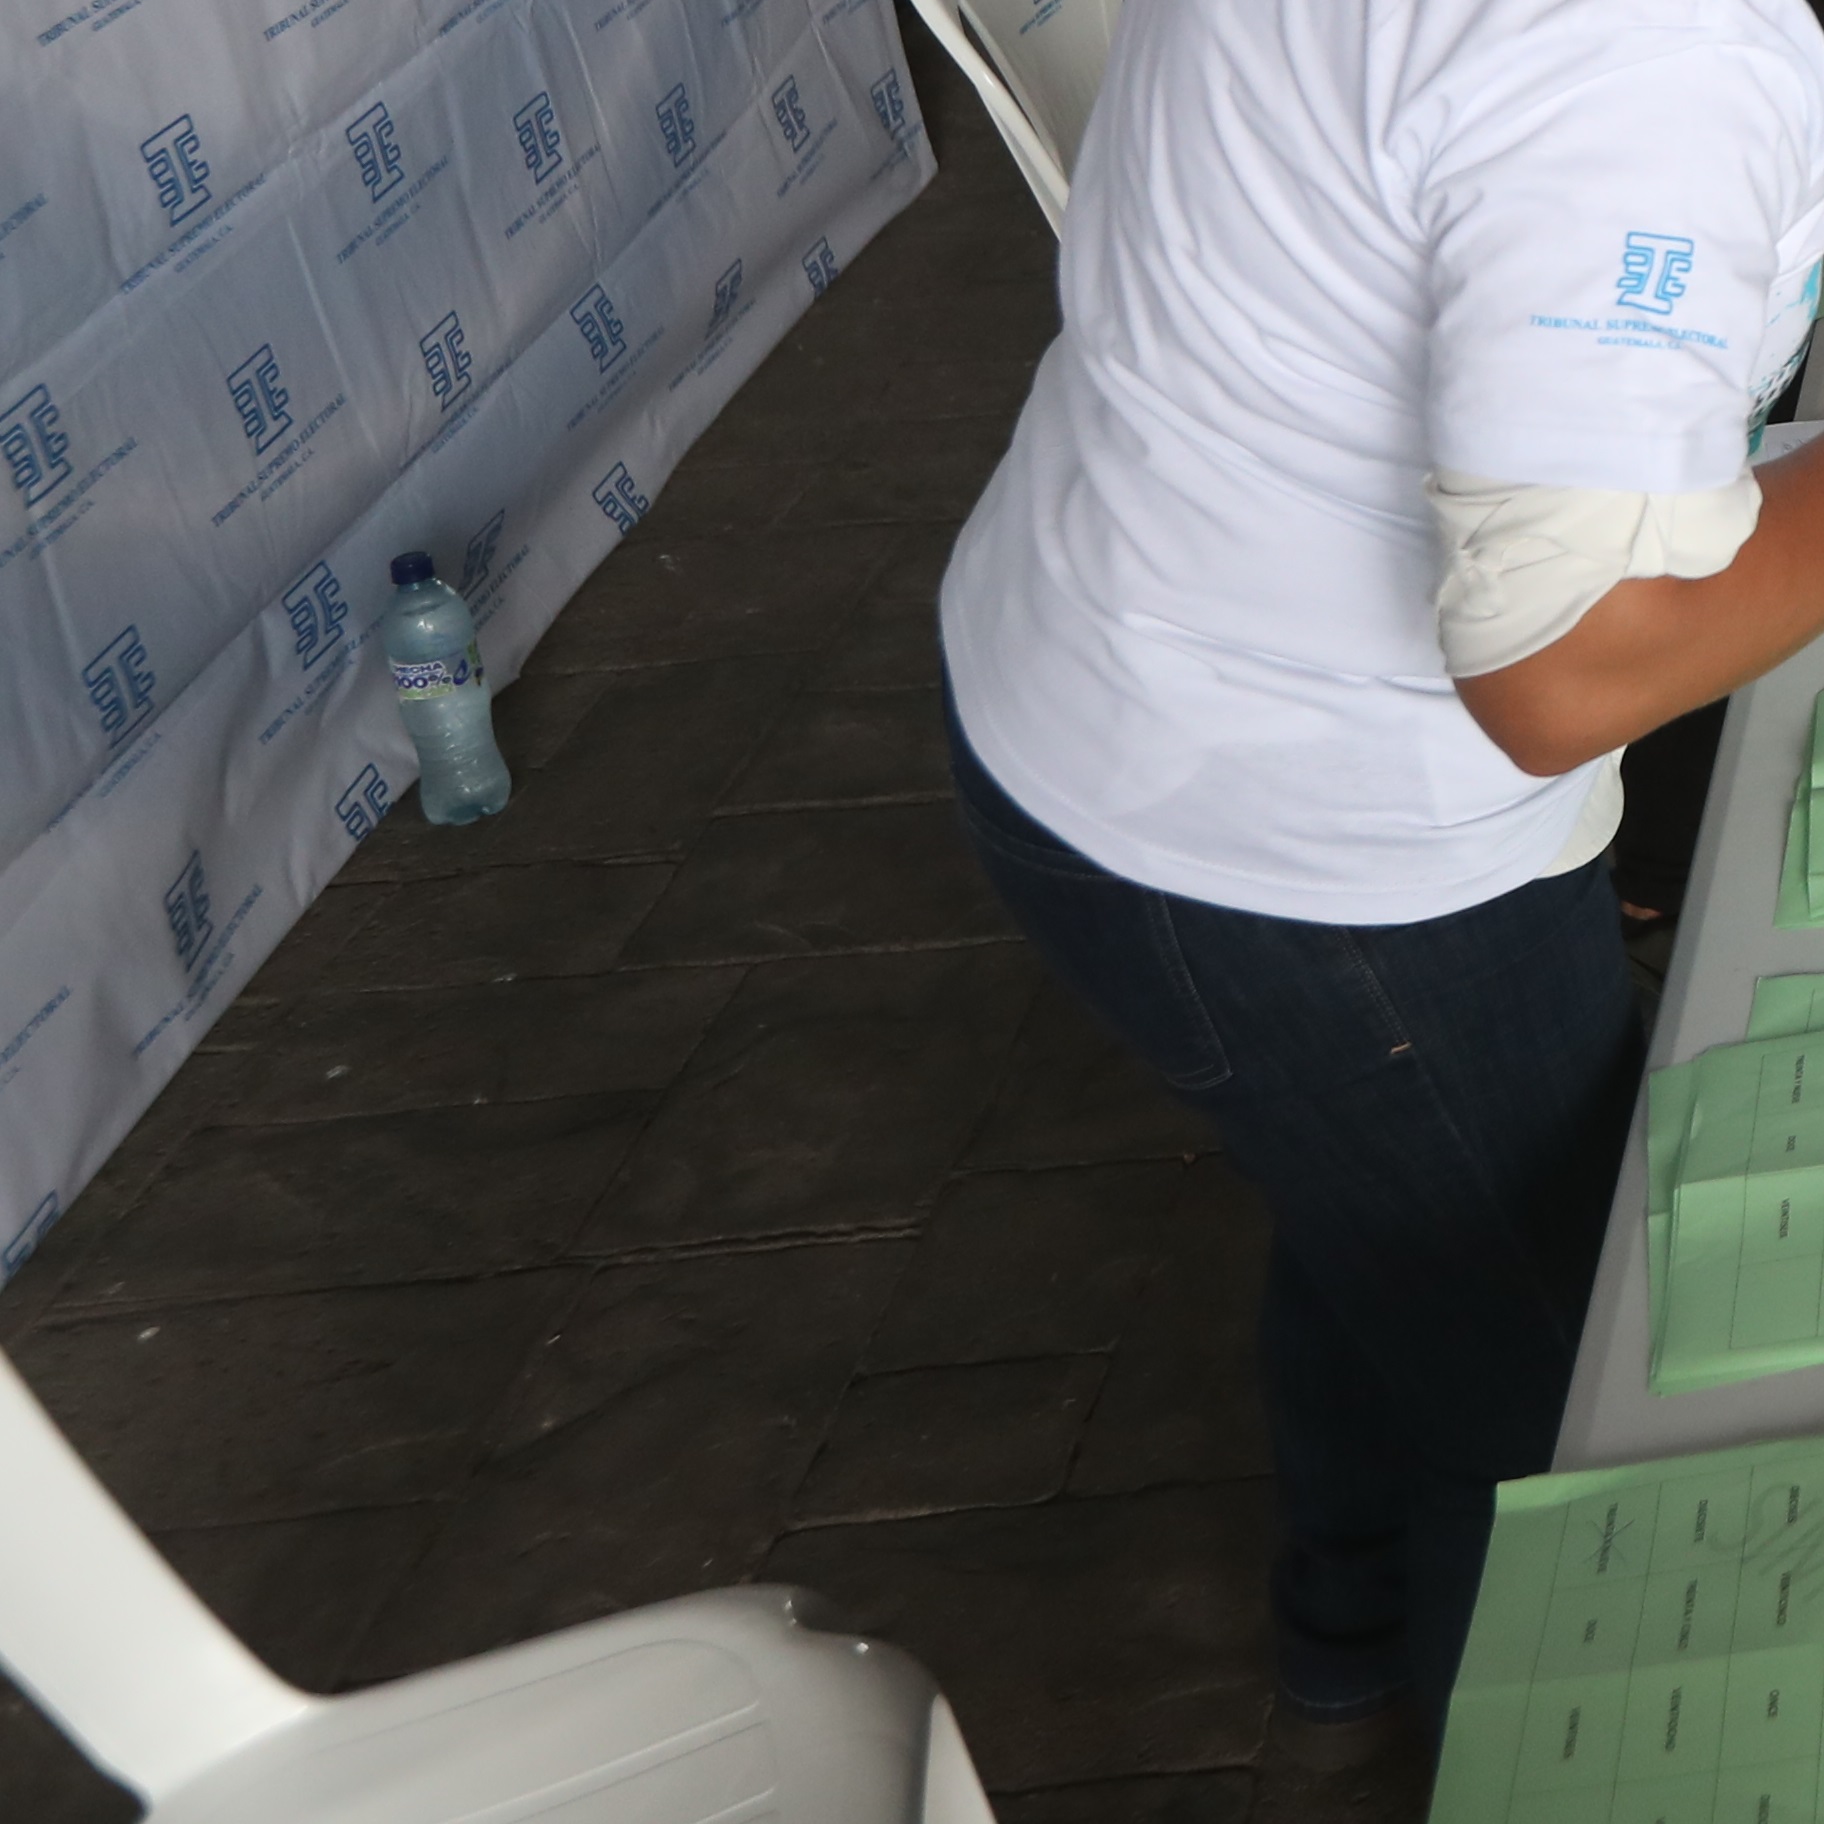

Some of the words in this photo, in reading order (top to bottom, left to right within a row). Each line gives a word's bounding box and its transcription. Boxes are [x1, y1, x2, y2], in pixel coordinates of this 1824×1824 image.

[36, 6, 91, 48] TRIBUNAL
[263, 4, 309, 42] TRIBUNAL
[1529, 314, 1601, 331] TRIBUNAL
